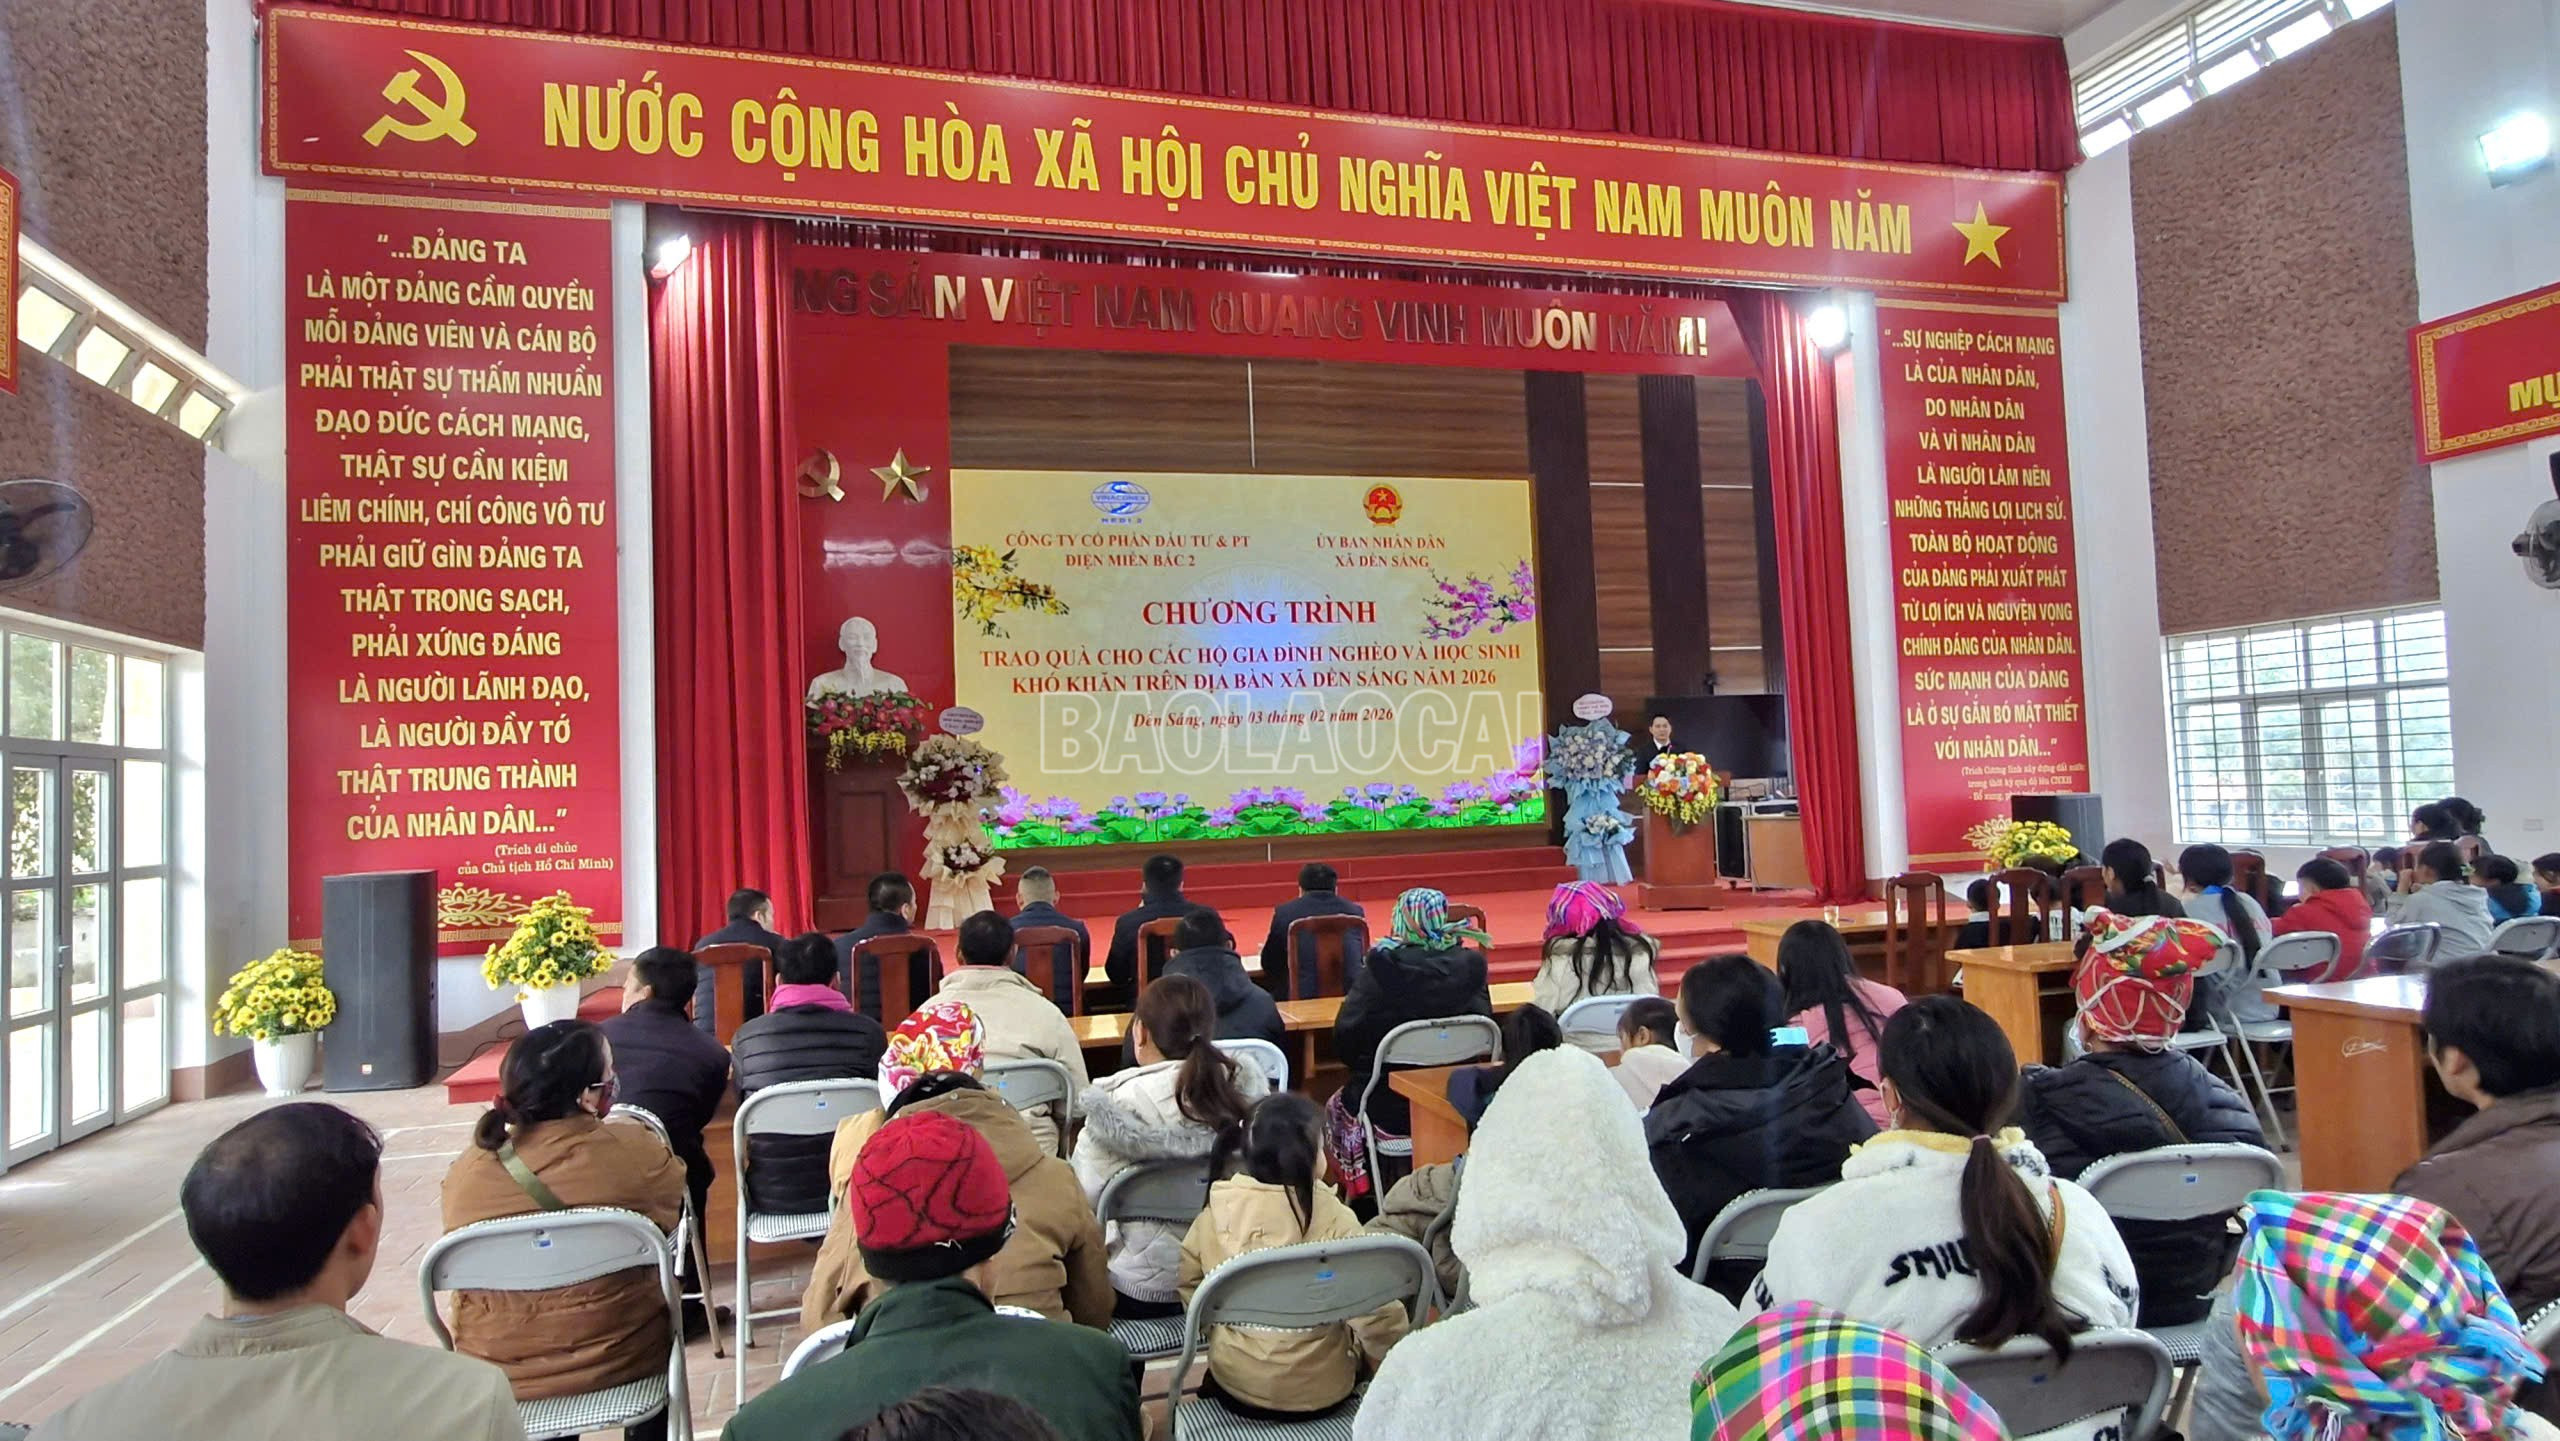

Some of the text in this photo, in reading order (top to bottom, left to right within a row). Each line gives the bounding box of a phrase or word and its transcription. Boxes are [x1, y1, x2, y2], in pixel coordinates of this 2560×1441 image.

[544, 71, 1911, 254] NƯỚC CỘNG HÒA XÃ HỘI CHỦ NGHĨA VIỆT NAM MUÔN NĂM
[493, 241, 526, 265] TA
[307, 269, 593, 310] LÀ MỘT ĐẢNG CẦM QUYỀN
[868, 260, 966, 321] SẢN
[980, 271, 1081, 338] VIỆT
[1094, 284, 1197, 332] NAM
[1209, 288, 1363, 340] QUANG
[1373, 299, 1466, 347] VINH
[1480, 298, 1598, 352] MUÔN
[1608, 303, 1708, 357] NĂM!
[1925, 328, 1973, 355] NGHIỆP
[1977, 331, 2012, 352] CÁCH
[2016, 336, 2055, 360] MẠNG
[1905, 358, 2039, 389] LÀ CỦA NHÂN DÂN,
[316, 405, 589, 445] ĐẠO ĐỨC CÁCH MẠNG,
[1918, 462, 2050, 486] LÀ NGƯỜI LÀM NÊN
[1895, 495, 1942, 518] NHỮNG
[1945, 490, 1989, 519] THẮNG
[1993, 501, 2012, 525] LỢI
[2016, 502, 2042, 524] LỊCH
[321, 535, 583, 568] PHẢI GIỮ GÌN ĐẢNG TA
[1005, 530, 1052, 548] CÔNG
[1056, 535, 1080, 548] TY
[1216, 536, 1228, 548] &
[1231, 536, 1250, 548] PT
[1339, 536, 1369, 548] BAN
[1909, 530, 2057, 559] TOÀN BỘ HOẠT ĐỘNG
[1188, 554, 1196, 567] 2
[1335, 552, 1354, 568] XÃ
[1392, 552, 1430, 568] SÁNG
[1142, 595, 1377, 626] CHƯƠNG TRÌNH
[353, 624, 560, 657] PHẢI XỨNG ĐÁNG
[980, 641, 1521, 669] TRAO QUÀ CHO CÁC HỘ GIA ĐÌNH NGHÈO VÀ HỌC SINH
[1903, 629, 2075, 656] CHÍNH ĐÁNG CỦA NHÂN DÂN.
[340, 671, 589, 706] LÀ NGƯỜI LÃNH ĐẠO,
[1012, 672, 1060, 694] KHÓ
[1066, 672, 1127, 693] KHĂN
[1132, 670, 1188, 691] TRÊN
[1194, 673, 1229, 694] ĐỊA
[1234, 670, 1274, 688] BÀN
[1279, 666, 1307, 688] XÃ
[1356, 666, 1408, 687] SÁNG
[1413, 667, 1456, 686] NĂM
[1461, 669, 1496, 685] 2026
[1915, 662, 2069, 699] SỨC MẠNH CỦA ĐẢNG
[361, 711, 570, 748] LÀ NGƯỜI ĐẦY TỚ
[1210, 713, 1243, 728] ngày
[1248, 712, 1263, 724] 03
[1310, 709, 1325, 722] 02
[1362, 708, 1393, 721] 2026
[1935, 736, 1960, 759] VỚI
[1963, 735, 2004, 758] NHÂN
[337, 759, 576, 801] THẬT TRUNG THÀNH
[348, 805, 400, 840] CỦA
[408, 806, 476, 837] NHÂN
[495, 841, 578, 857] (Trích di chúc
[457, 856, 614, 876] của Chủ tịch Hồ Chí Minh)
